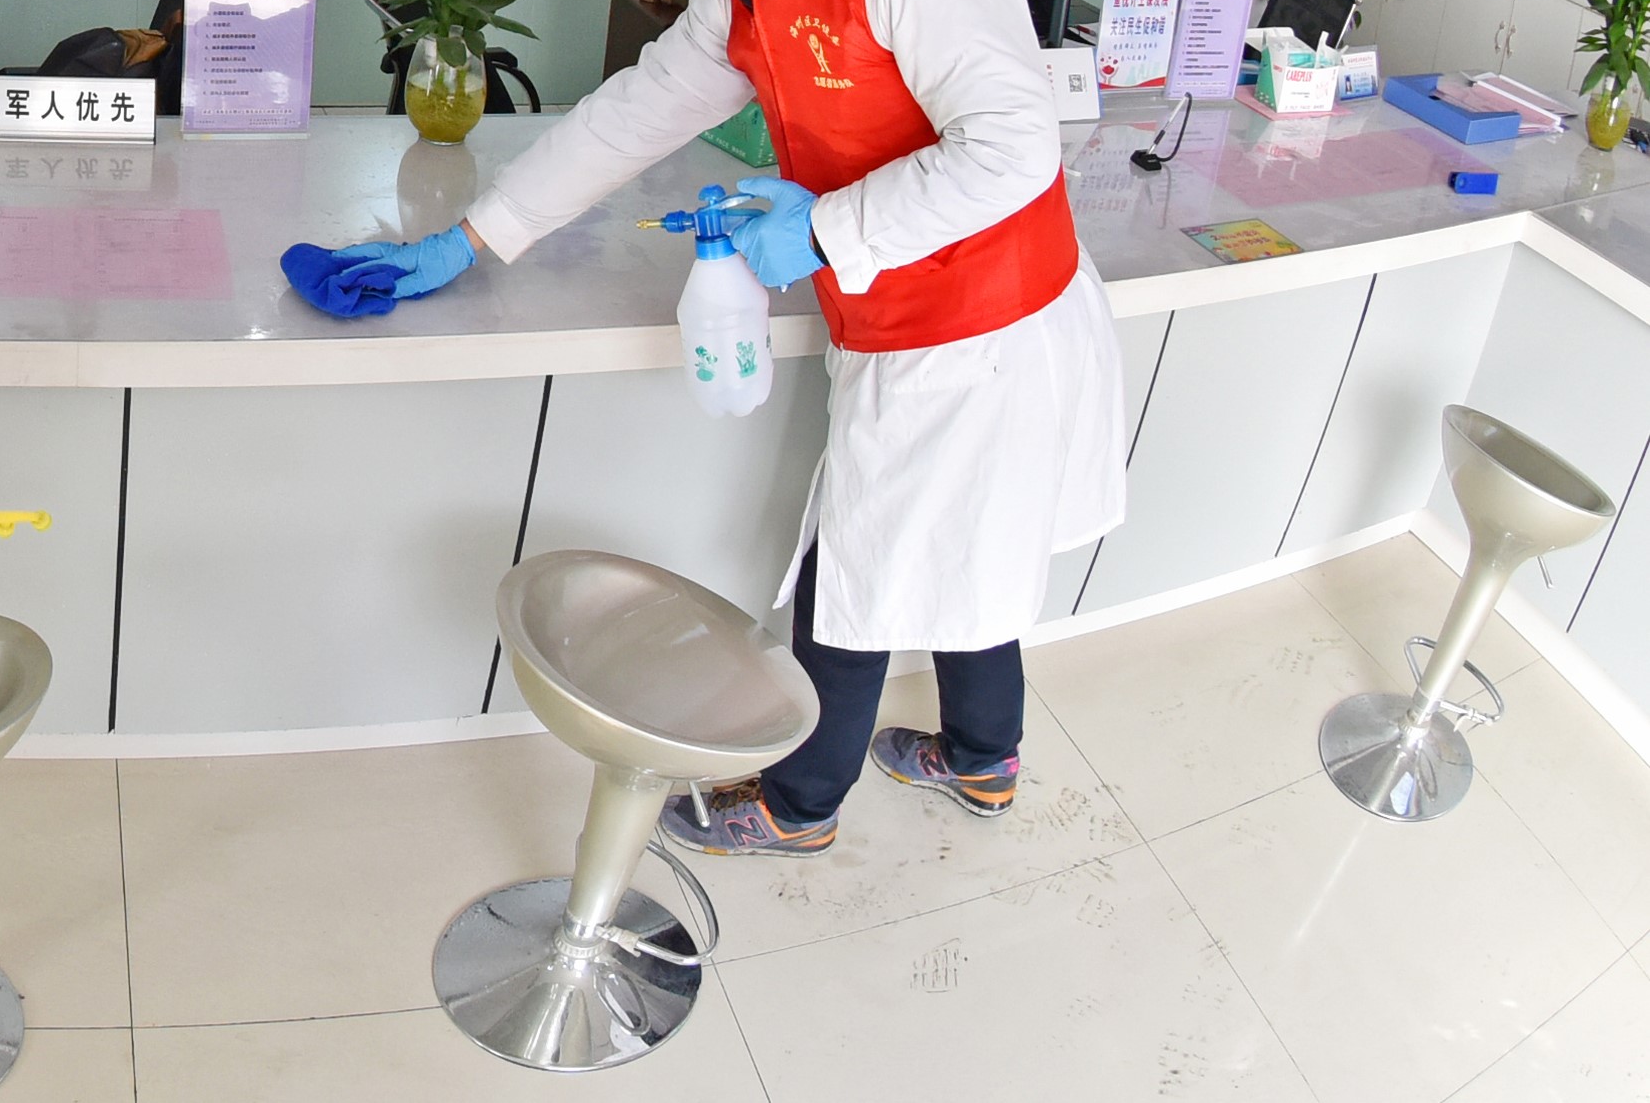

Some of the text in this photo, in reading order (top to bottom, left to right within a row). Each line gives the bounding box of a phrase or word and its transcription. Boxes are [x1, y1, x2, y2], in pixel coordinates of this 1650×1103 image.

[5, 88, 135, 123] 军人优先
[916, 749, 949, 778] N
[724, 815, 767, 846] N
